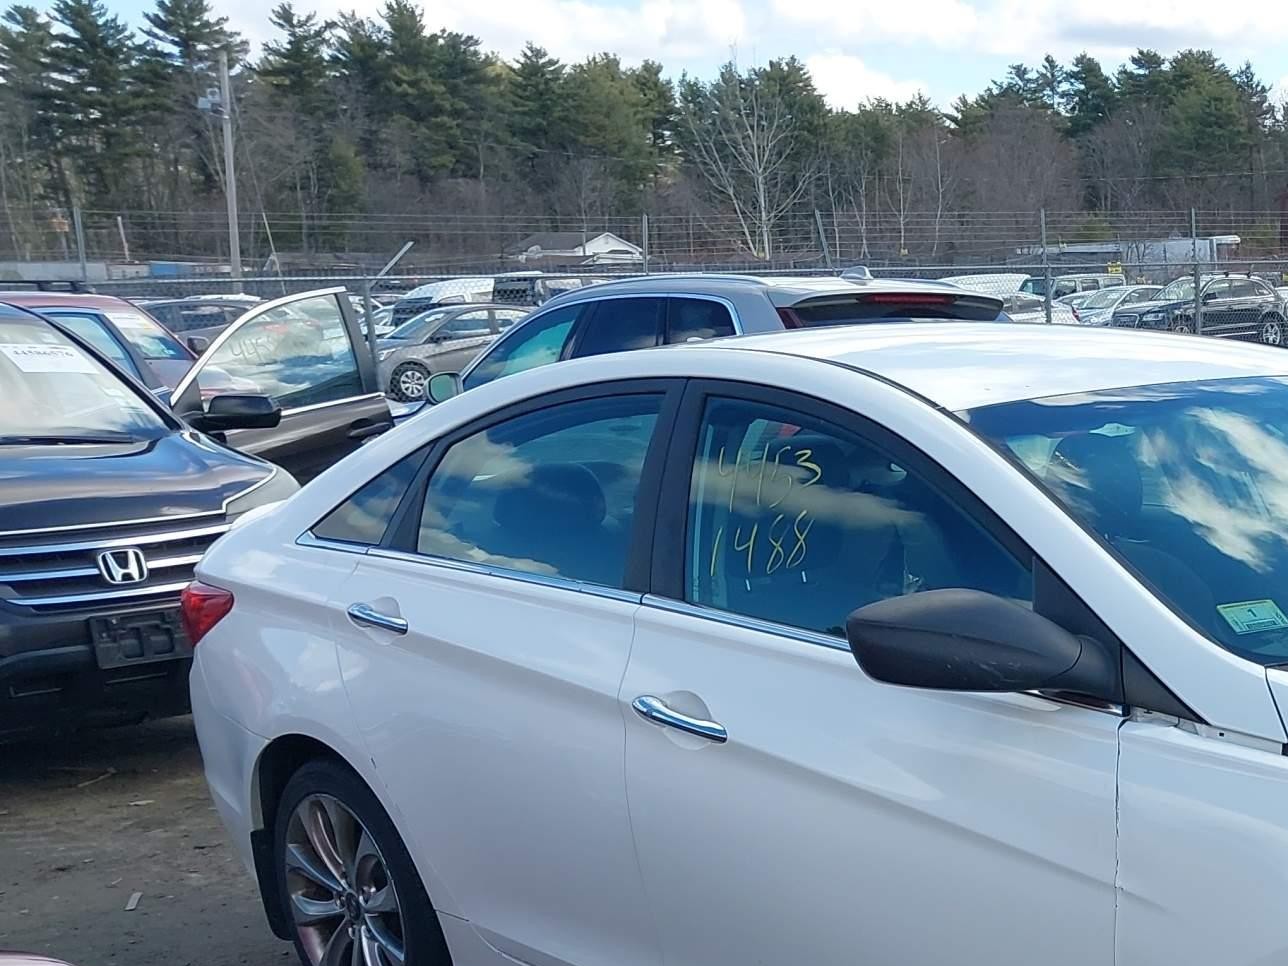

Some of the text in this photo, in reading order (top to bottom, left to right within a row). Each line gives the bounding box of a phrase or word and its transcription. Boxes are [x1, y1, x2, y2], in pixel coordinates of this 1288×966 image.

[718, 442, 822, 513] 4453
[710, 509, 815, 577] 1488
[1247, 608, 1258, 618] 1
